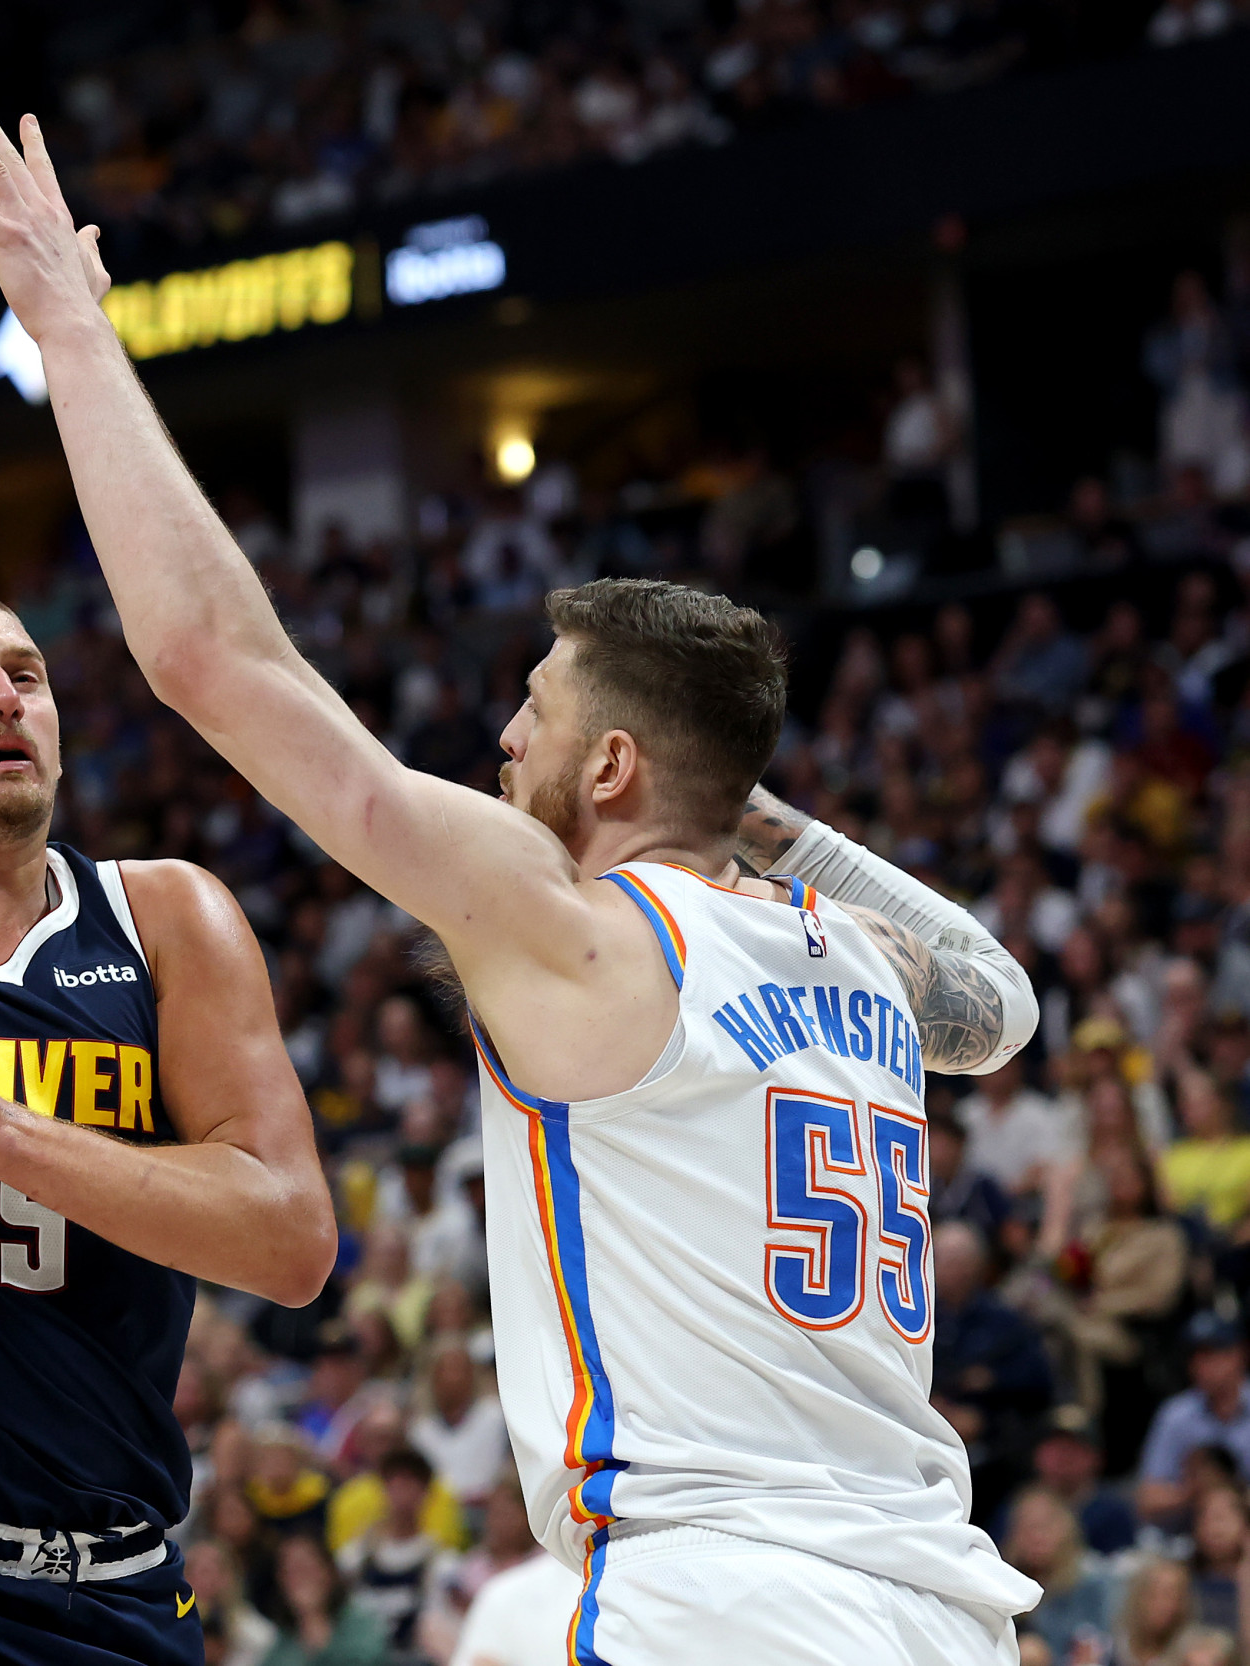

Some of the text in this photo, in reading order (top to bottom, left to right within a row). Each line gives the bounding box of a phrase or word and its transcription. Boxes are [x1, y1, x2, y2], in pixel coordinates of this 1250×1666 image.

[53, 964, 138, 988] ibotta
[712, 982, 921, 1100] HARENSTEIN
[764, 1086, 931, 1344] 55
